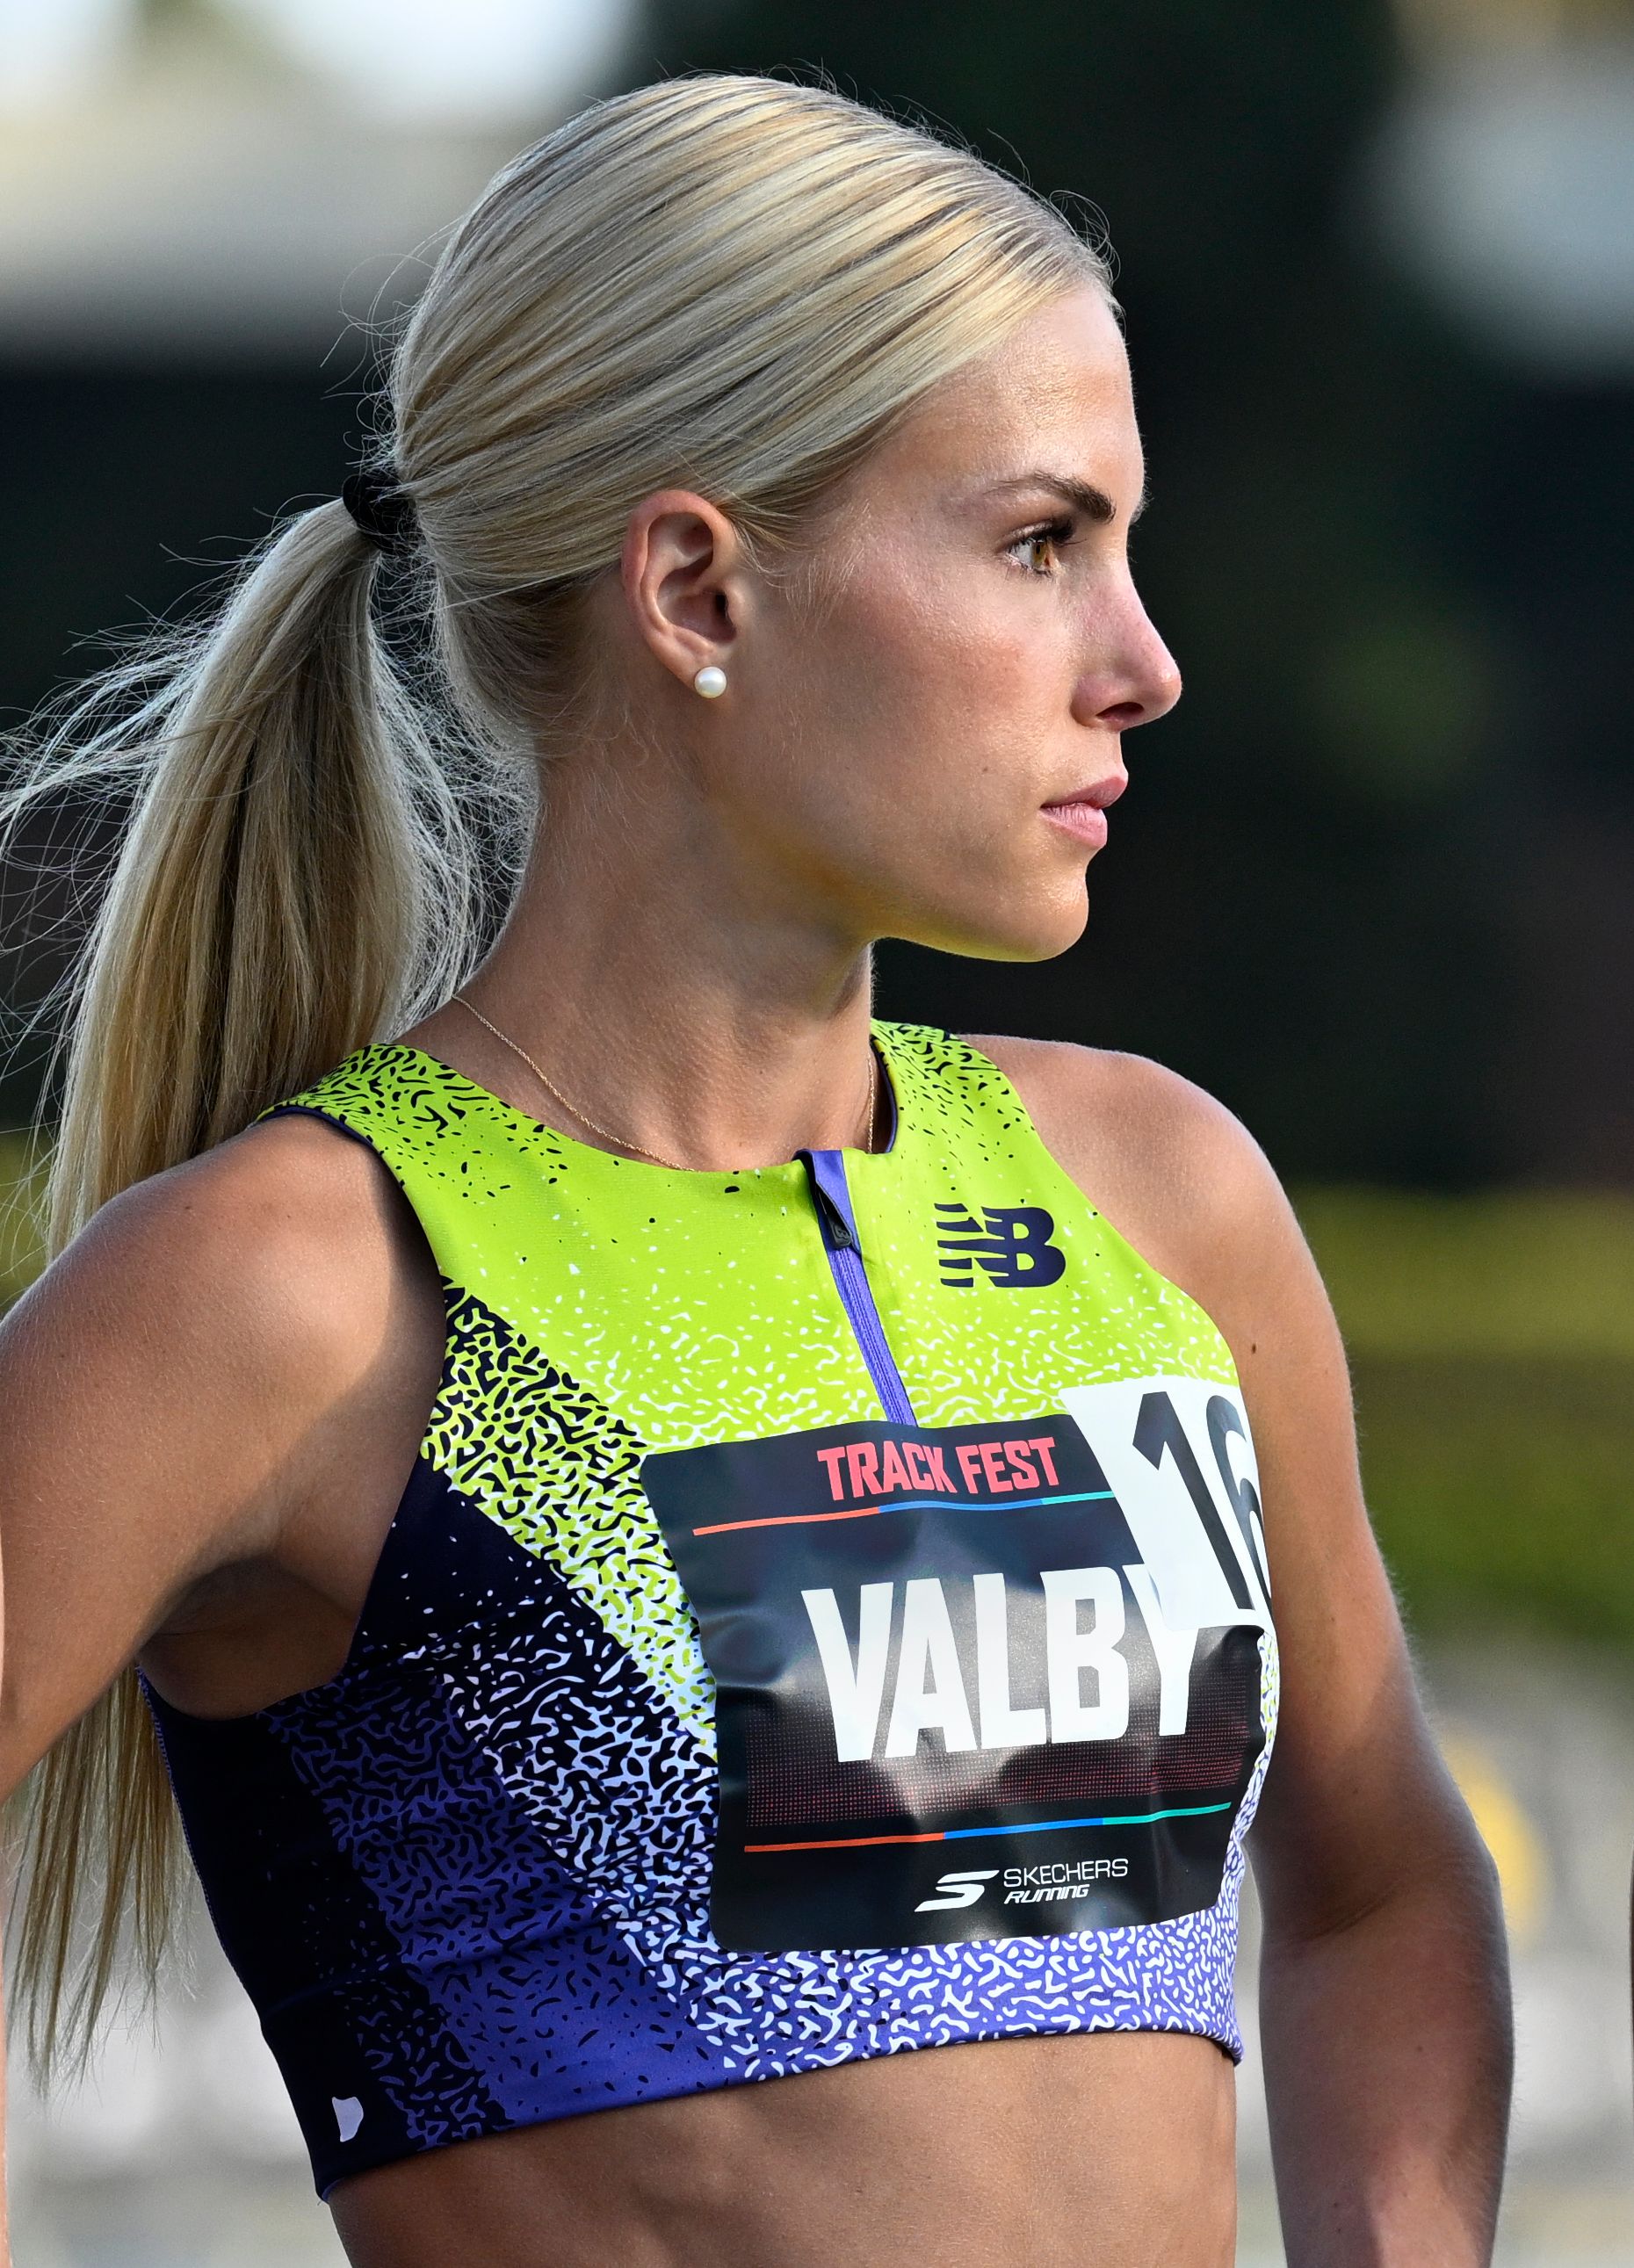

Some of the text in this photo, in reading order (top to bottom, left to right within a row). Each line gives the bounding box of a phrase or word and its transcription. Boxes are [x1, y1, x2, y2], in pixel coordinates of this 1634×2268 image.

[816, 1436, 1059, 1501] TRACK FEST
[801, 1563, 1199, 1763] VALBY
[1003, 1858, 1129, 1888] SKECHERS
[1003, 1883, 1090, 1904] RUNNING
